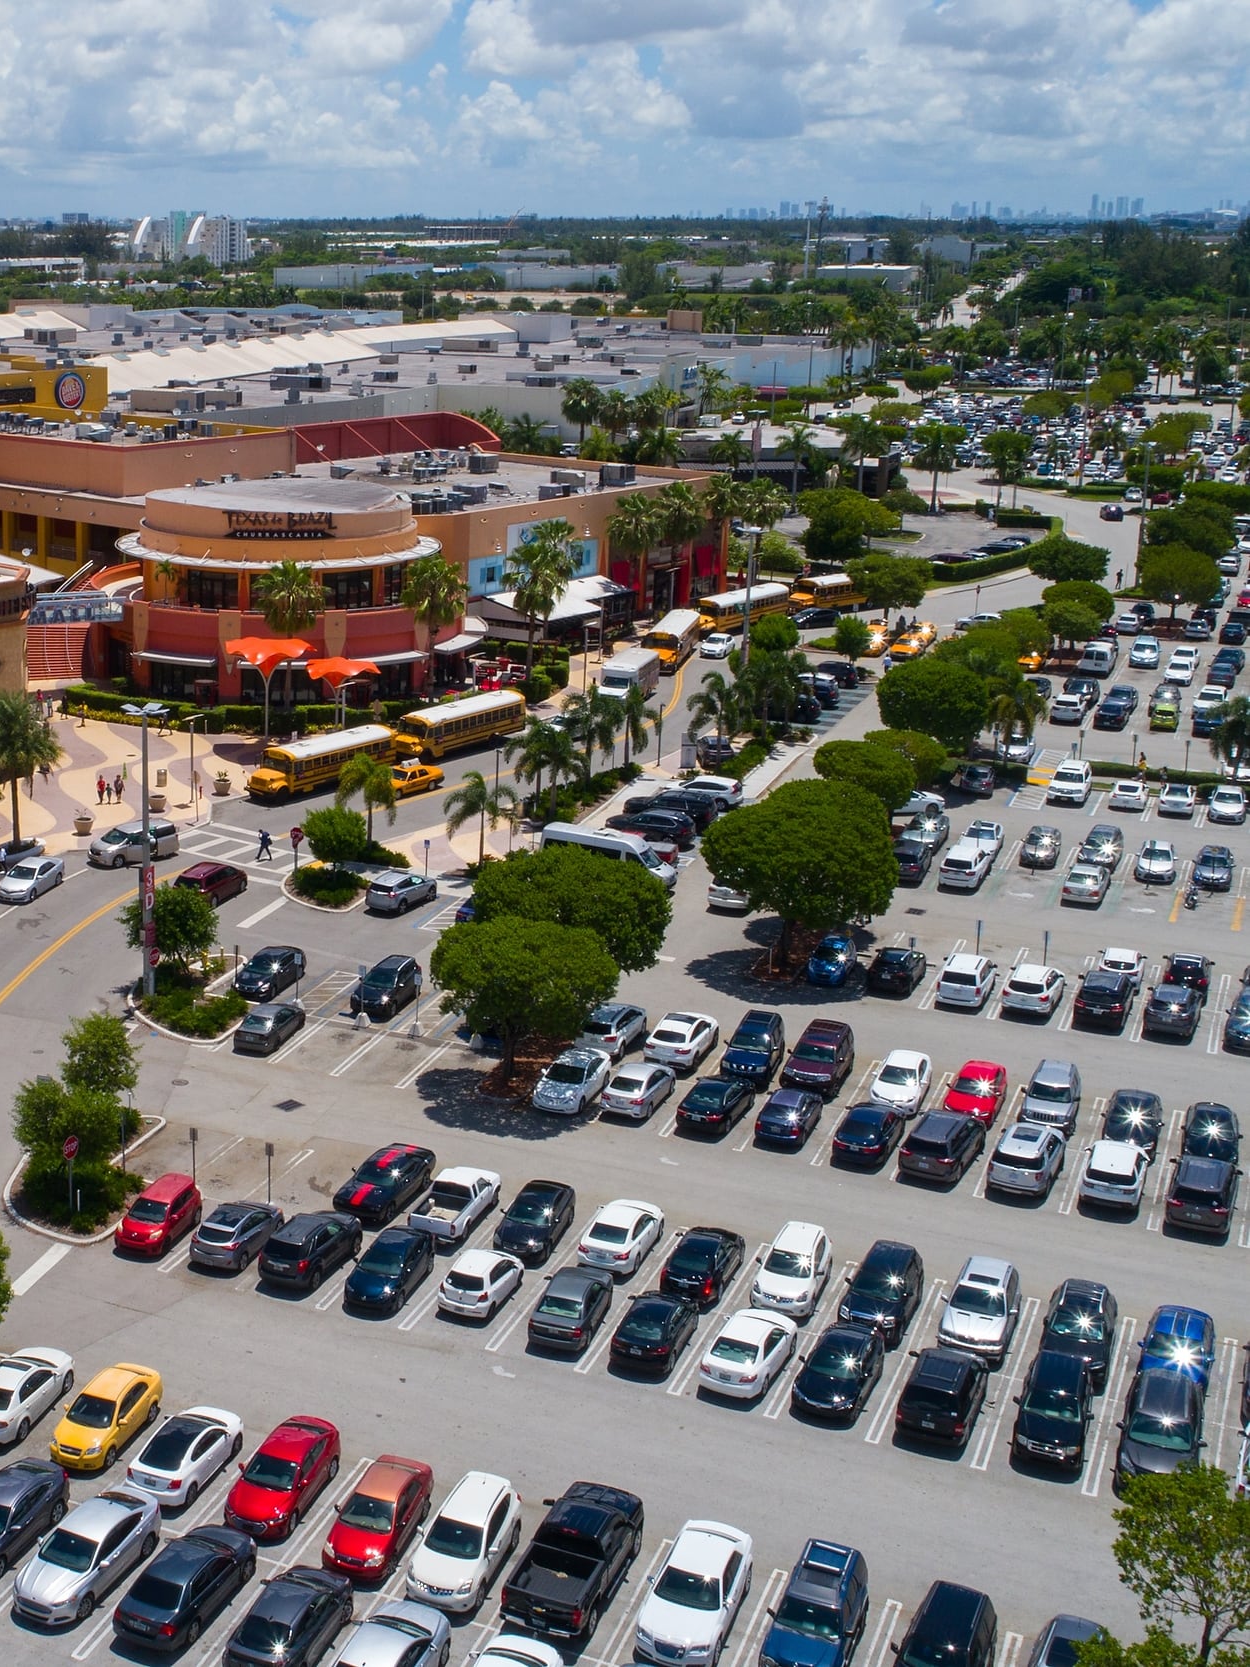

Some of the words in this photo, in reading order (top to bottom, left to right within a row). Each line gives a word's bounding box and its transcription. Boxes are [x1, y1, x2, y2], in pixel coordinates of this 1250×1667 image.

[222, 510, 269, 529] TEXAS
[286, 511, 337, 530] BRAZIL
[27, 604, 96, 625] MALL
[146, 871, 153, 887] 3
[64, 1141, 78, 1154] STOP
